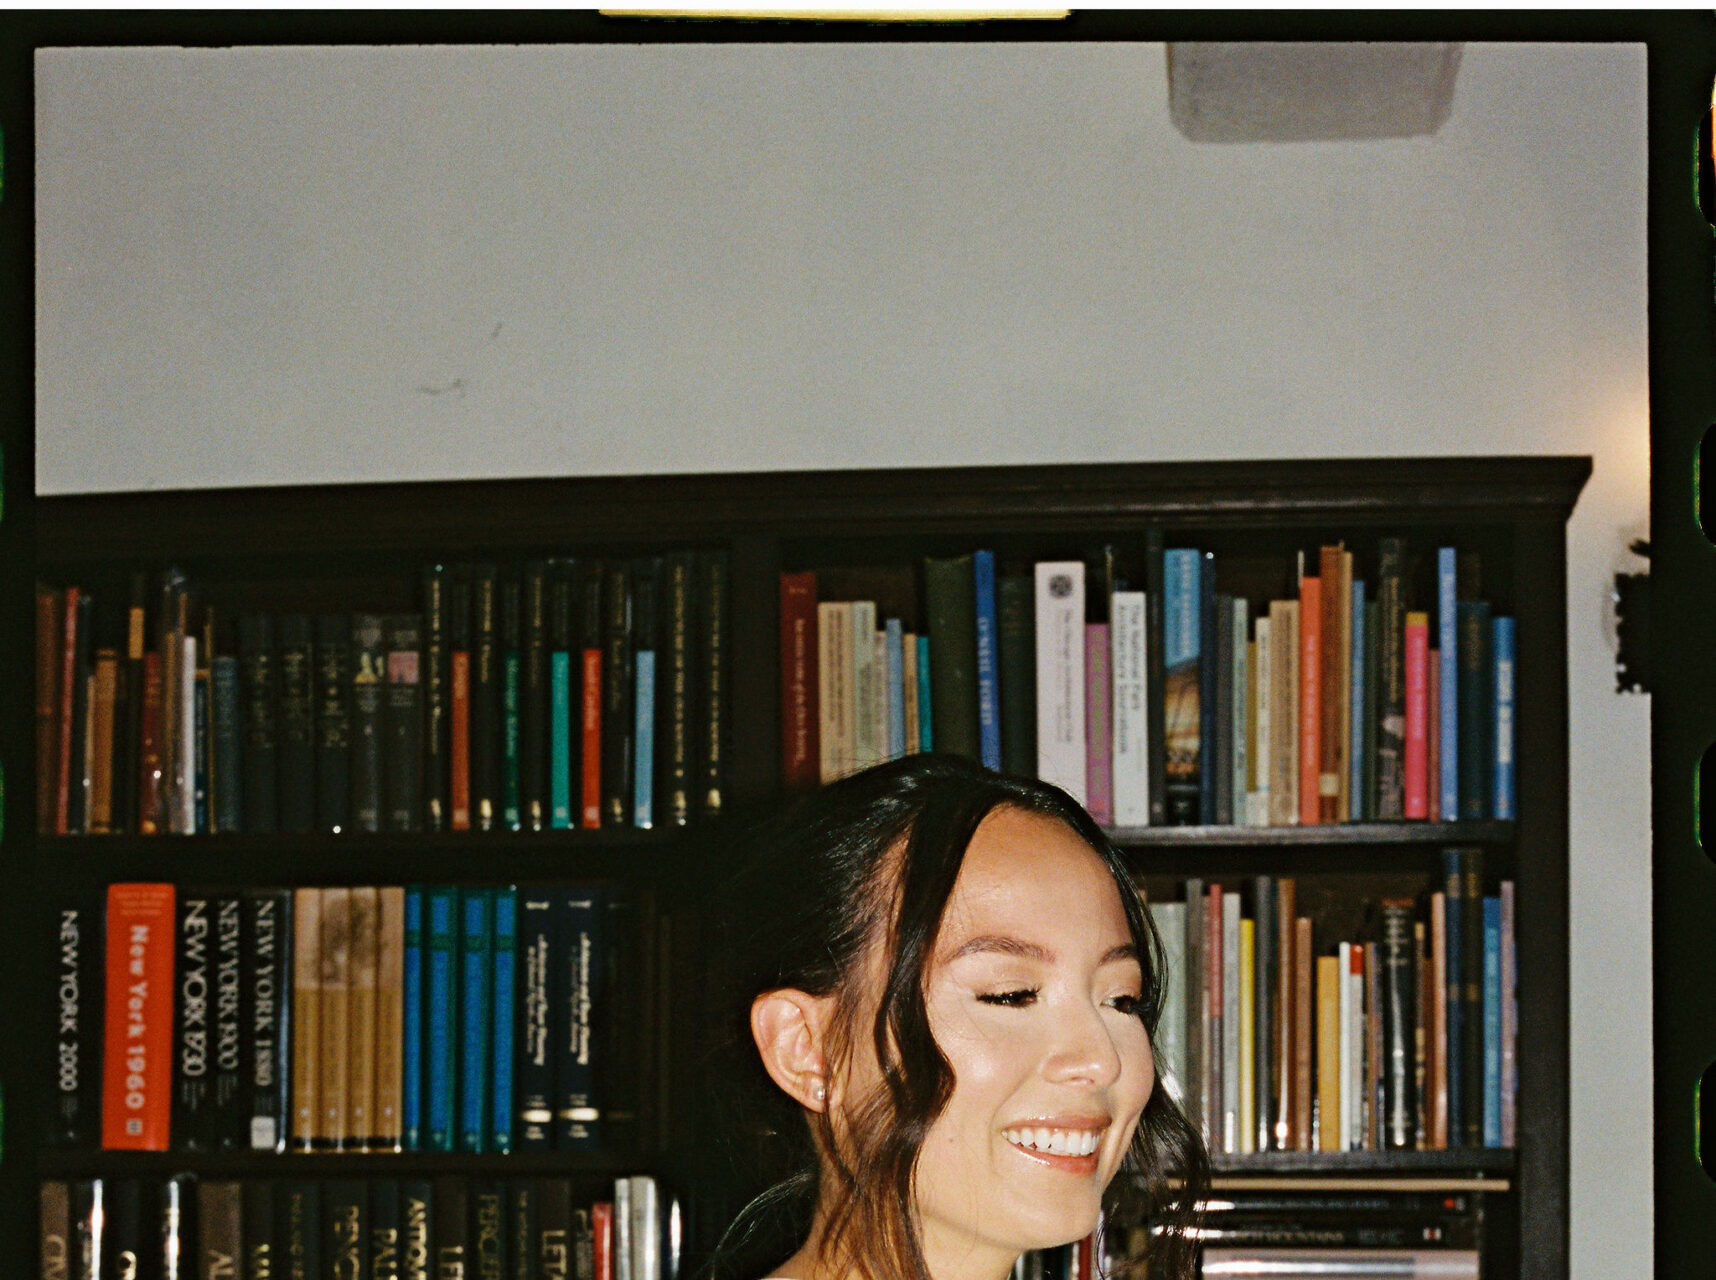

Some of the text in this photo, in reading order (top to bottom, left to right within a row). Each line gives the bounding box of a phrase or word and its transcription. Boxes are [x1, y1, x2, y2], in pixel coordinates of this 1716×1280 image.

[59, 911, 78, 1091] NEW YORK 2000
[182, 900, 207, 1076] NEW YORK 1930
[218, 900, 239, 1069] NEW YORK 1900
[255, 900, 274, 957] NEW
[255, 965, 274, 1032] YORK
[126, 925, 149, 1110] New York 1960
